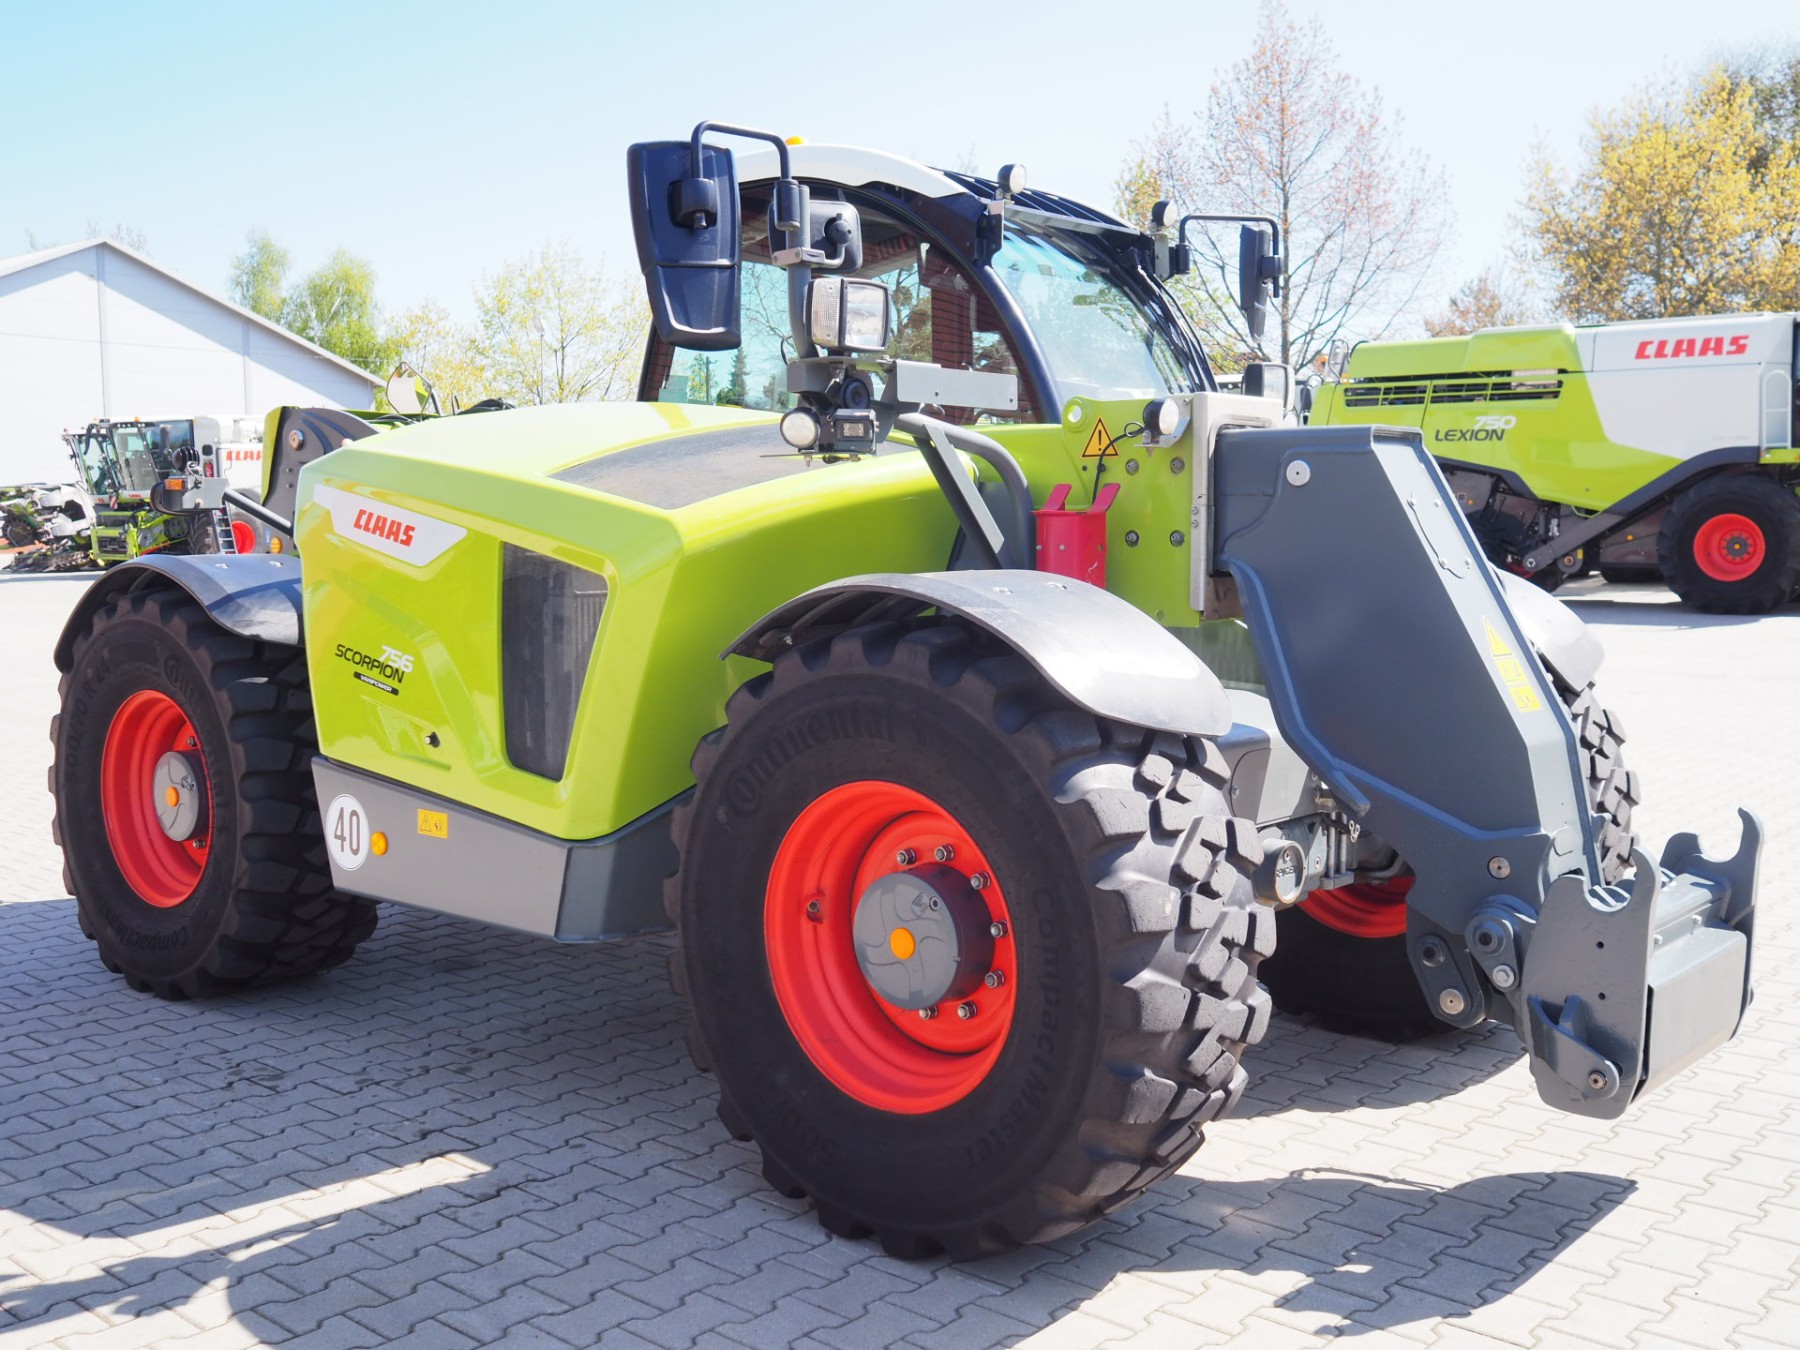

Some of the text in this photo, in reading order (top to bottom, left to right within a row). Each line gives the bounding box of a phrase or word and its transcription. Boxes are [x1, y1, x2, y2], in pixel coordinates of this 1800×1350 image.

[1635, 335, 1749, 360] CLAAS
[1434, 429, 1505, 442] LEXION
[1474, 415, 1517, 430] 750
[353, 508, 416, 547] CLAAS
[334, 643, 405, 683] SCORPION
[379, 645, 414, 673] 756
[725, 701, 897, 819] Continental
[334, 806, 361, 856] 40
